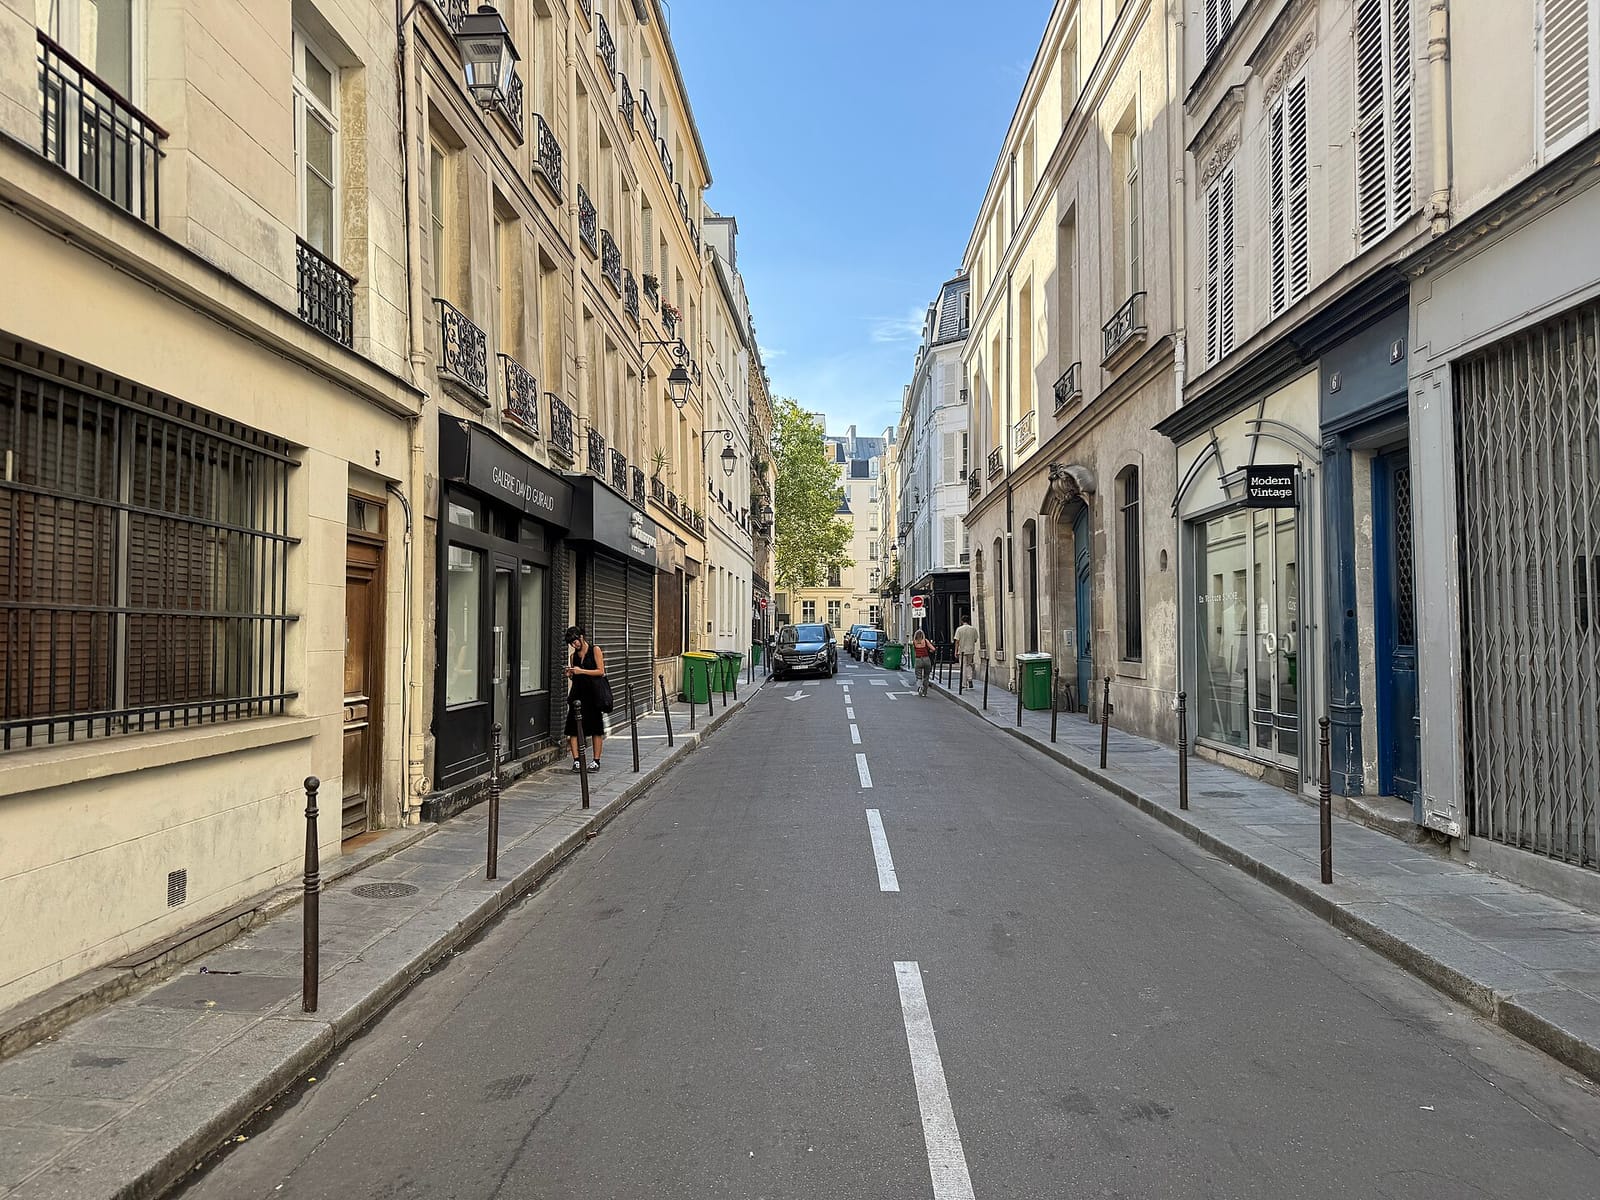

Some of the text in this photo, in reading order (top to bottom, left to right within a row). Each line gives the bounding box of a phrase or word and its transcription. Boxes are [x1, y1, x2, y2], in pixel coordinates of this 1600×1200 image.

[1392, 342, 1399, 358] 4
[1331, 375, 1337, 389] 6
[492, 466, 515, 493] GALERIE
[515, 479, 532, 501] DAVID
[1251, 476, 1291, 486] Modern
[1250, 488, 1292, 499] Vintage
